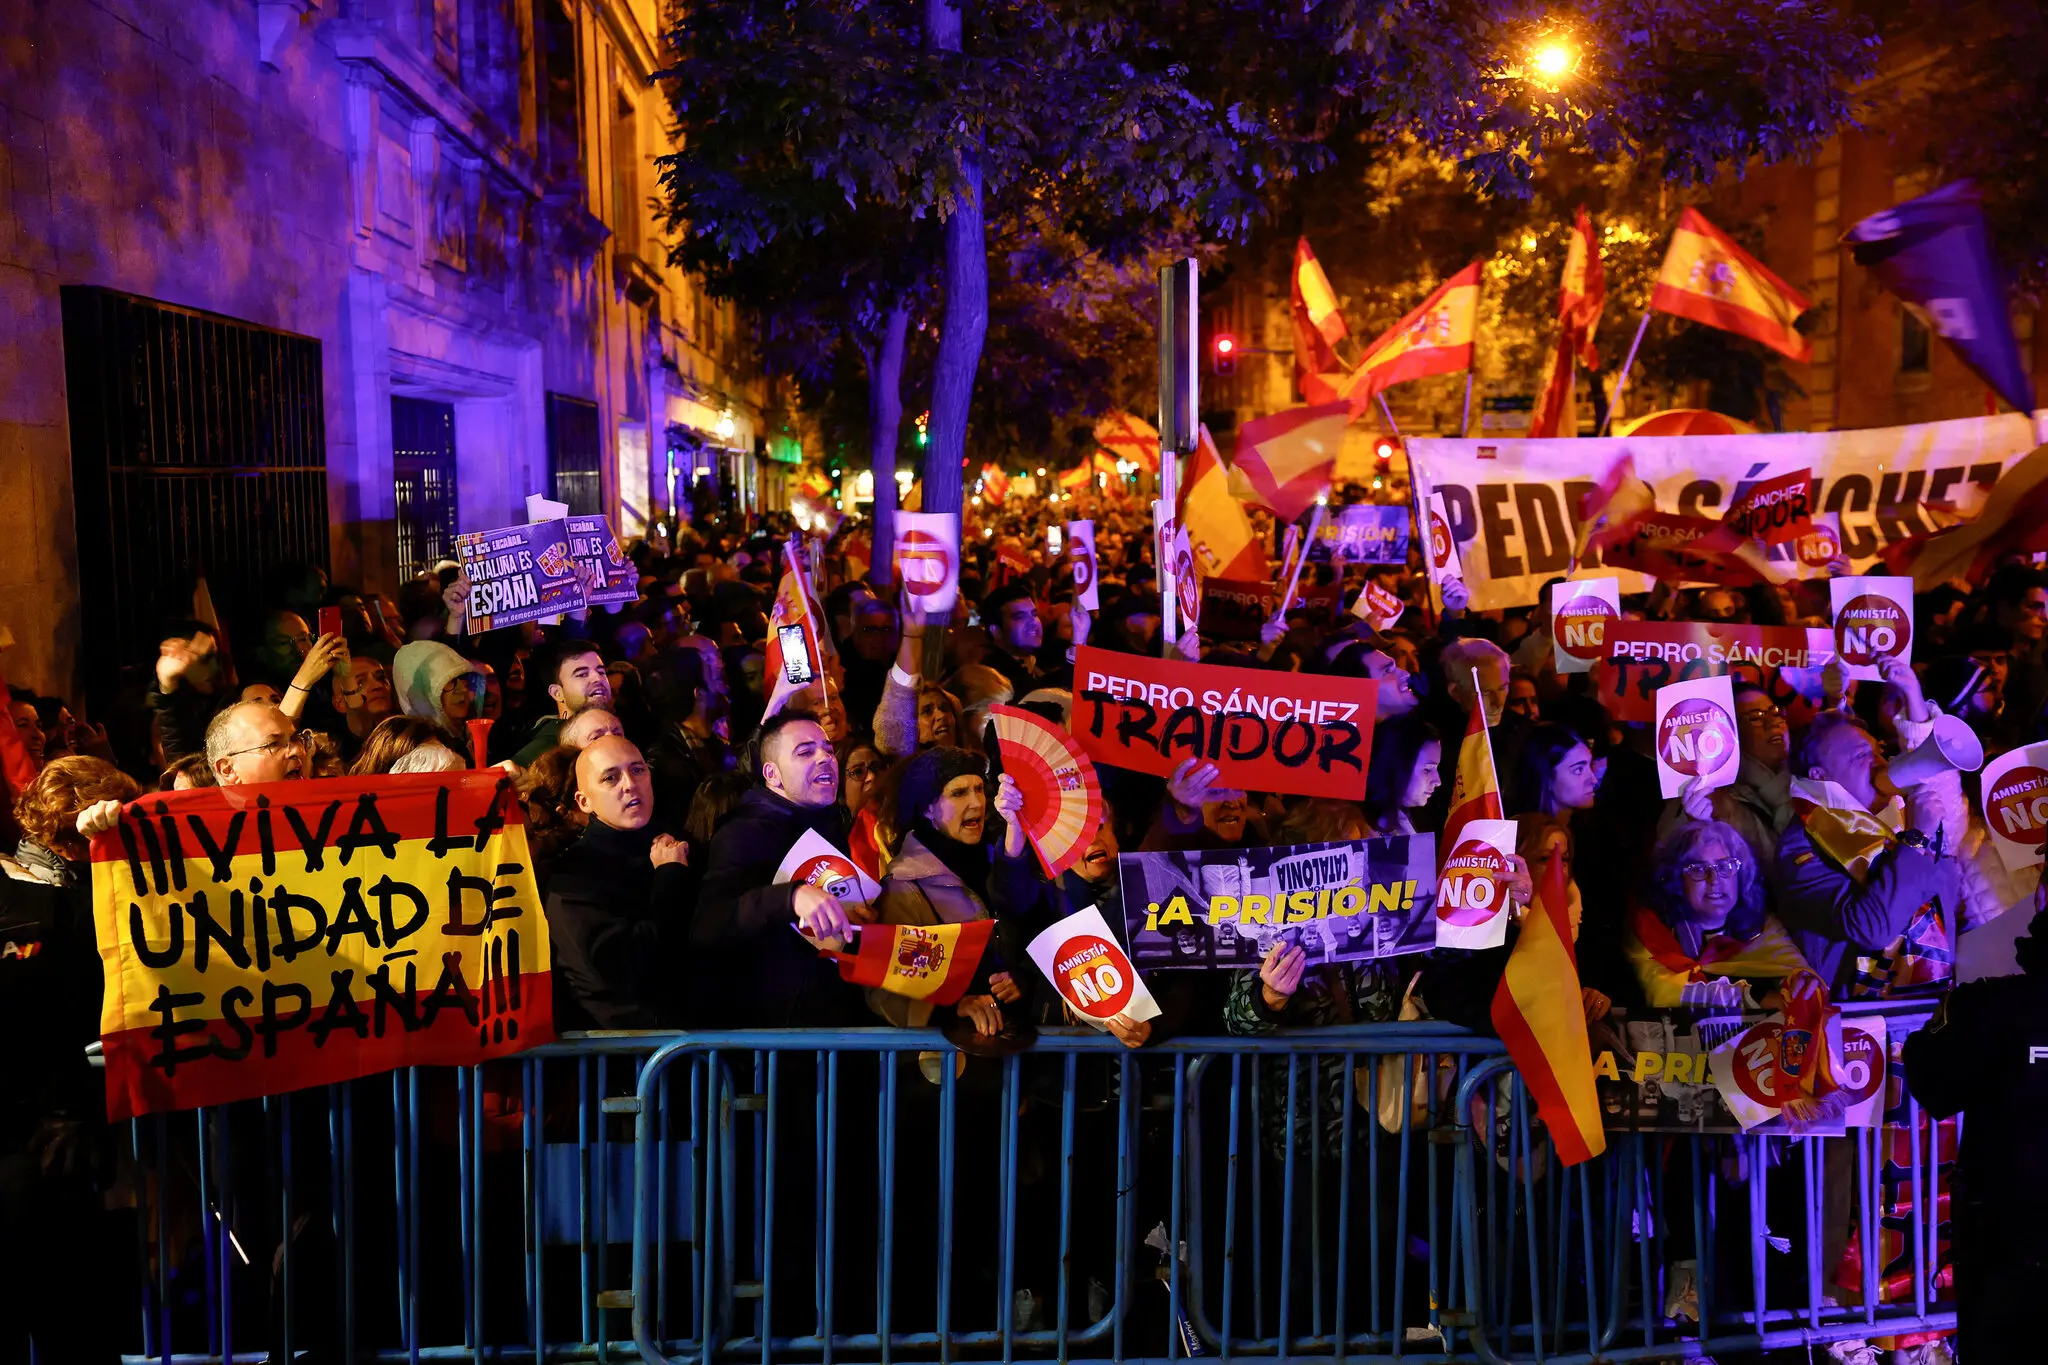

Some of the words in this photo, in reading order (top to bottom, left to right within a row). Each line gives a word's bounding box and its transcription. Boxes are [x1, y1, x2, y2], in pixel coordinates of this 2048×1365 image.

[591, 537, 602, 555] ES
[465, 554, 518, 583] CATALUÑA
[518, 550, 533, 571] ES
[471, 573, 539, 618] ESPAÑA
[494, 598, 583, 625] www.democracianacional.org
[1561, 605, 1609, 618] AMNISTÍA
[1843, 607, 1899, 619] AMNISTÍA
[1613, 641, 1702, 663] PEDRO
[1707, 641, 1835, 669] SÁNCHEZ
[1843, 626, 1896, 654] NO
[1087, 671, 1194, 712] PEDRO
[1202, 687, 1359, 728] SÁNCHEZ
[1080, 690, 1362, 773] TRAIDOR
[1665, 708, 1721, 729] AMNISTÍA
[1669, 729, 1724, 764] NO
[426, 777, 511, 858] LA
[807, 860, 830, 885] STÍA
[1276, 853, 1349, 892] CATALONIA
[1446, 855, 1499, 870] AMNISTÍA
[1145, 895, 1193, 932] ¡A
[1206, 877, 1418, 926] PRISIÓN!
[1437, 877, 1495, 909] NO
[130, 874, 430, 974] UNIDAD
[441, 863, 524, 937] DE
[1058, 943, 1109, 974] AMNISTÍA
[1070, 964, 1123, 1008] NO
[1843, 1039, 1872, 1053] STÍA
[1843, 1059, 1871, 1090] O
